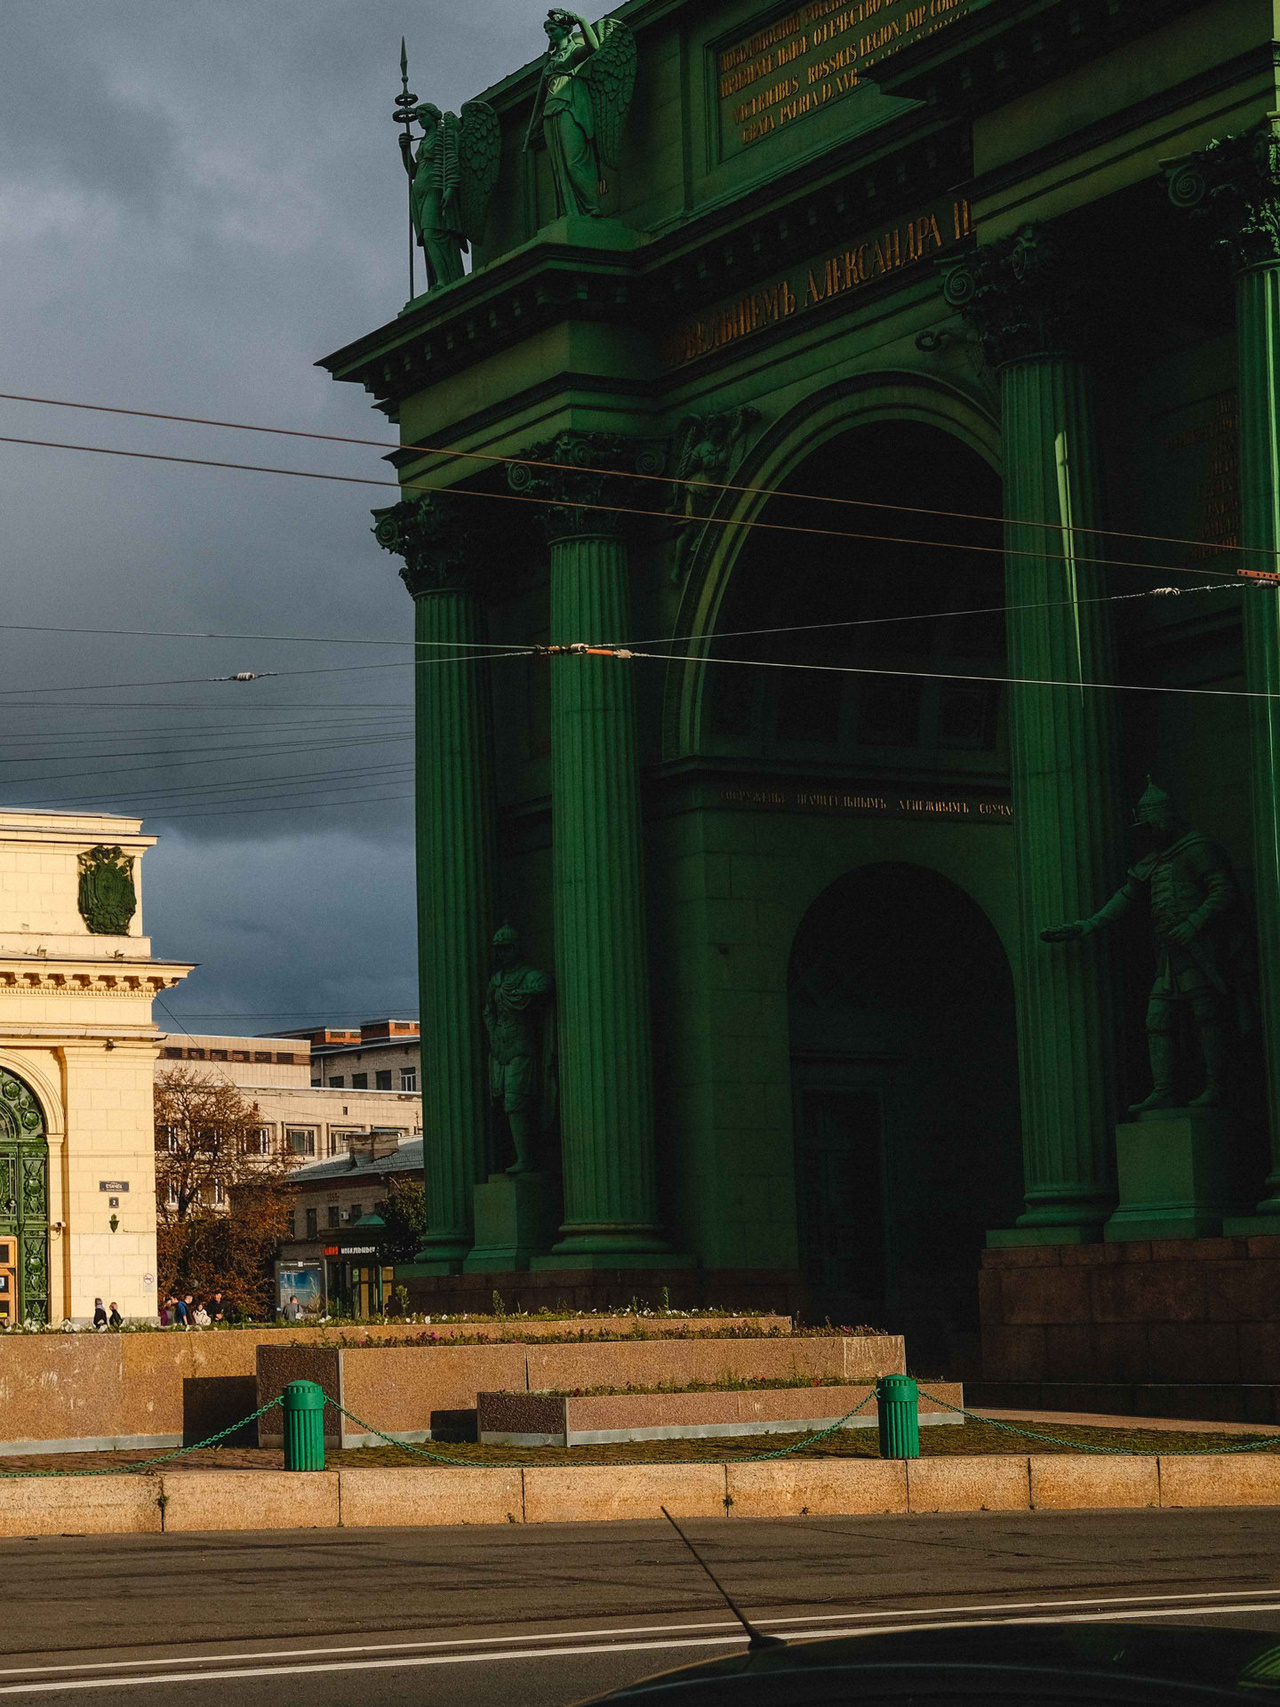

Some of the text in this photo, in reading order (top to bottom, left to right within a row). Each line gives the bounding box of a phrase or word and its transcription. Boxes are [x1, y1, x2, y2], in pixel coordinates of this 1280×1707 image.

[813, 0, 881, 47] ОТЕЧЕСТВО
[733, 75, 800, 125] VICTRICIBUS
[808, 43, 858, 85] ROSSICIS
[743, 114, 776, 145] GRATA
[780, 90, 820, 126] PATRIA
[804, 213, 943, 308] АЛЕКСАНДРА
